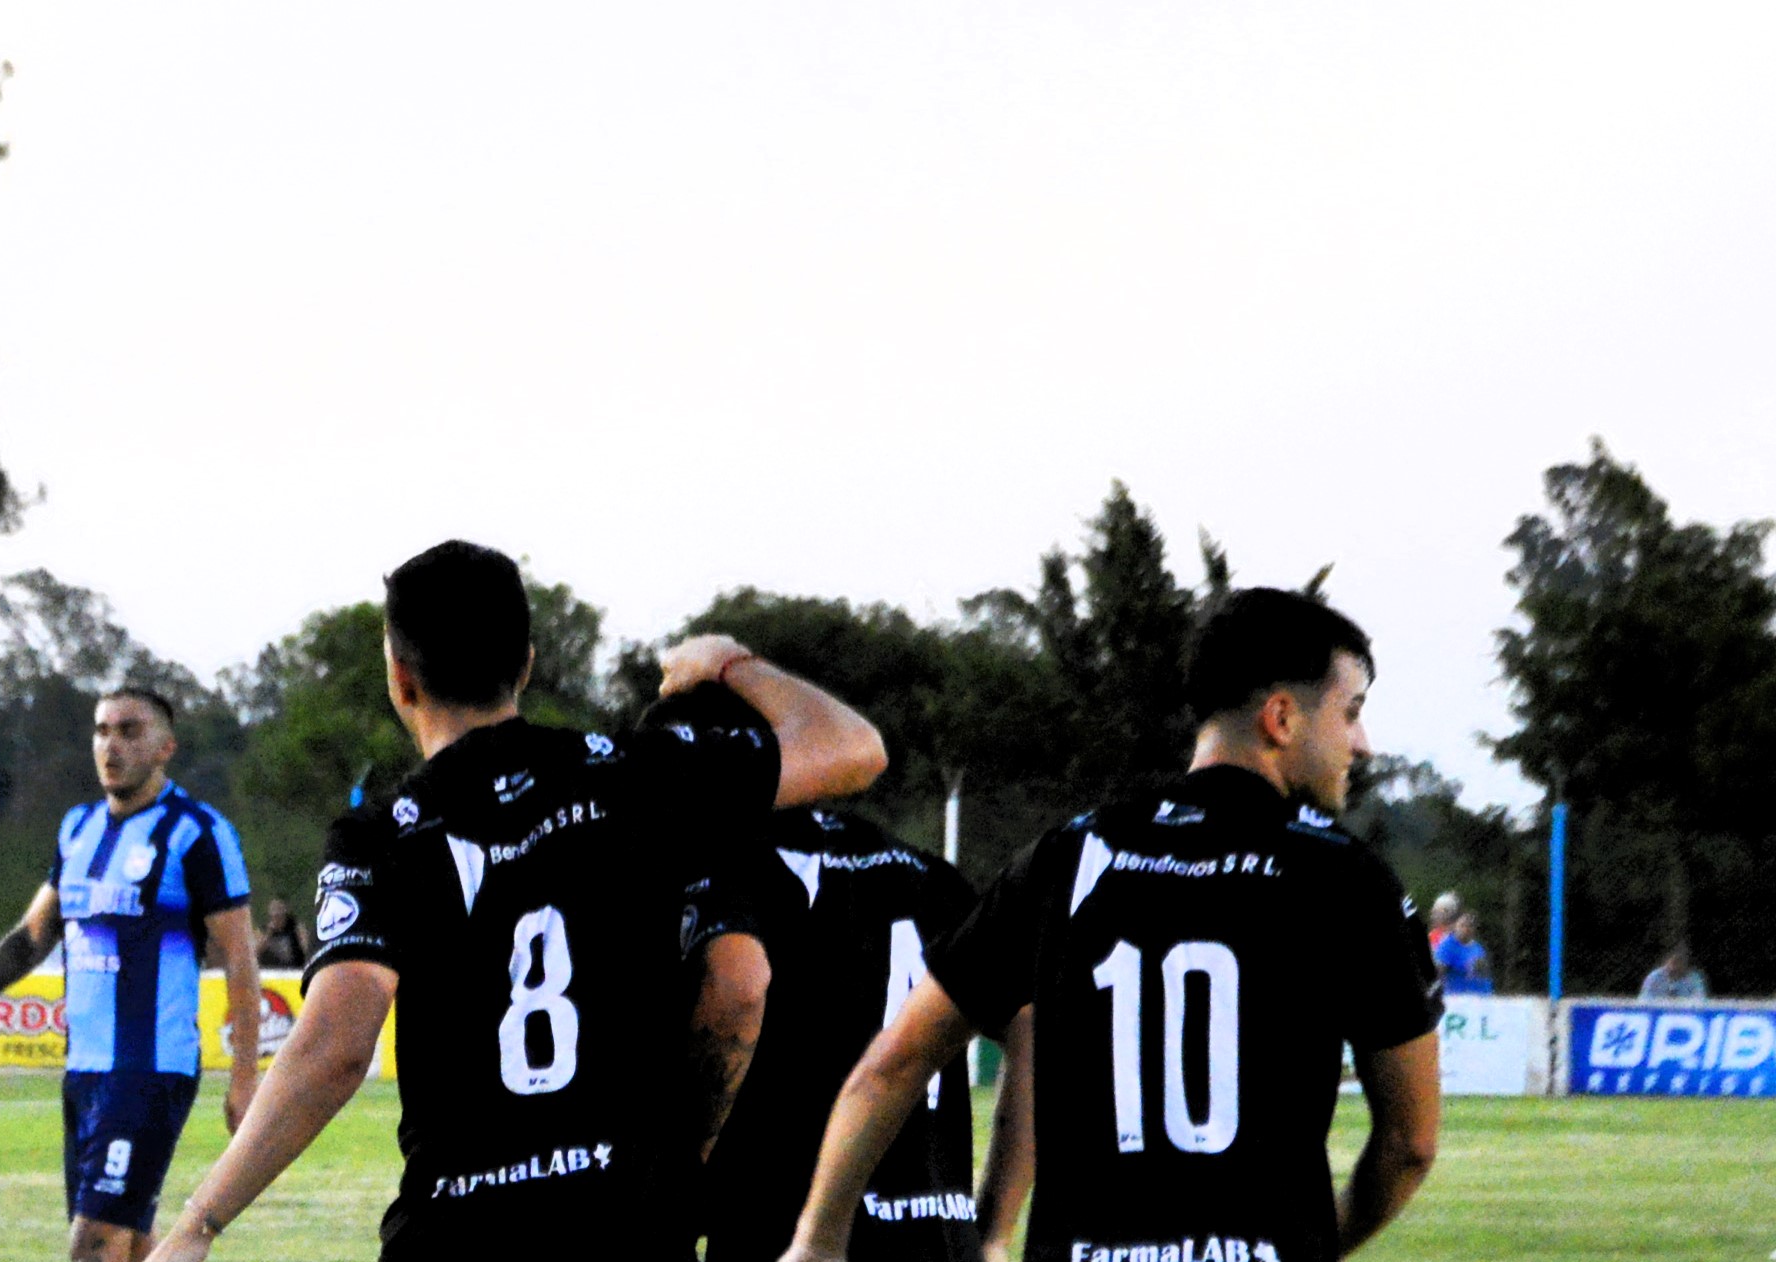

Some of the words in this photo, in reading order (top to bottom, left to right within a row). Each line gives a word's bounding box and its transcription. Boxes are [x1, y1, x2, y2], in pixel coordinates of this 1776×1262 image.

[498, 904, 579, 1095] 8
[1092, 939, 1240, 1154] 10
[104, 1138, 132, 1178] 9
